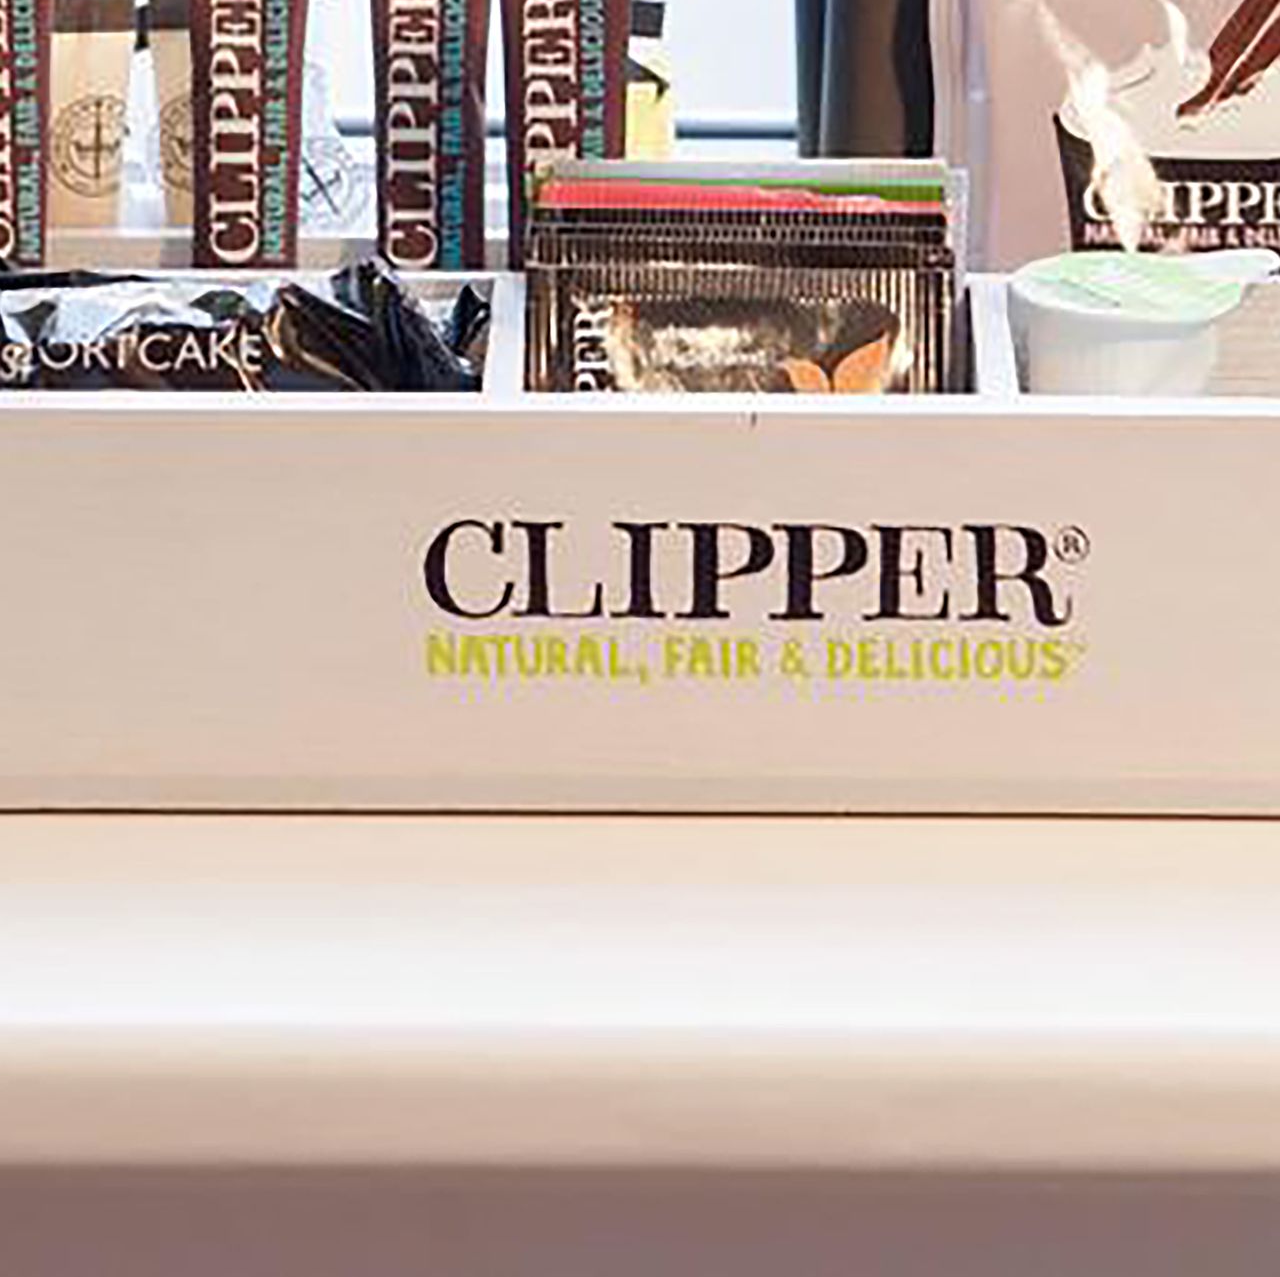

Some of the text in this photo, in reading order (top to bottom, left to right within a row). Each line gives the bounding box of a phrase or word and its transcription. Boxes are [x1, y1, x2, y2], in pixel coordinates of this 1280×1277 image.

[424, 520, 1089, 626] CLIPPER®
[426, 633, 648, 684] NATURAL,
[664, 637, 760, 679] FAIR
[779, 638, 807, 679] &
